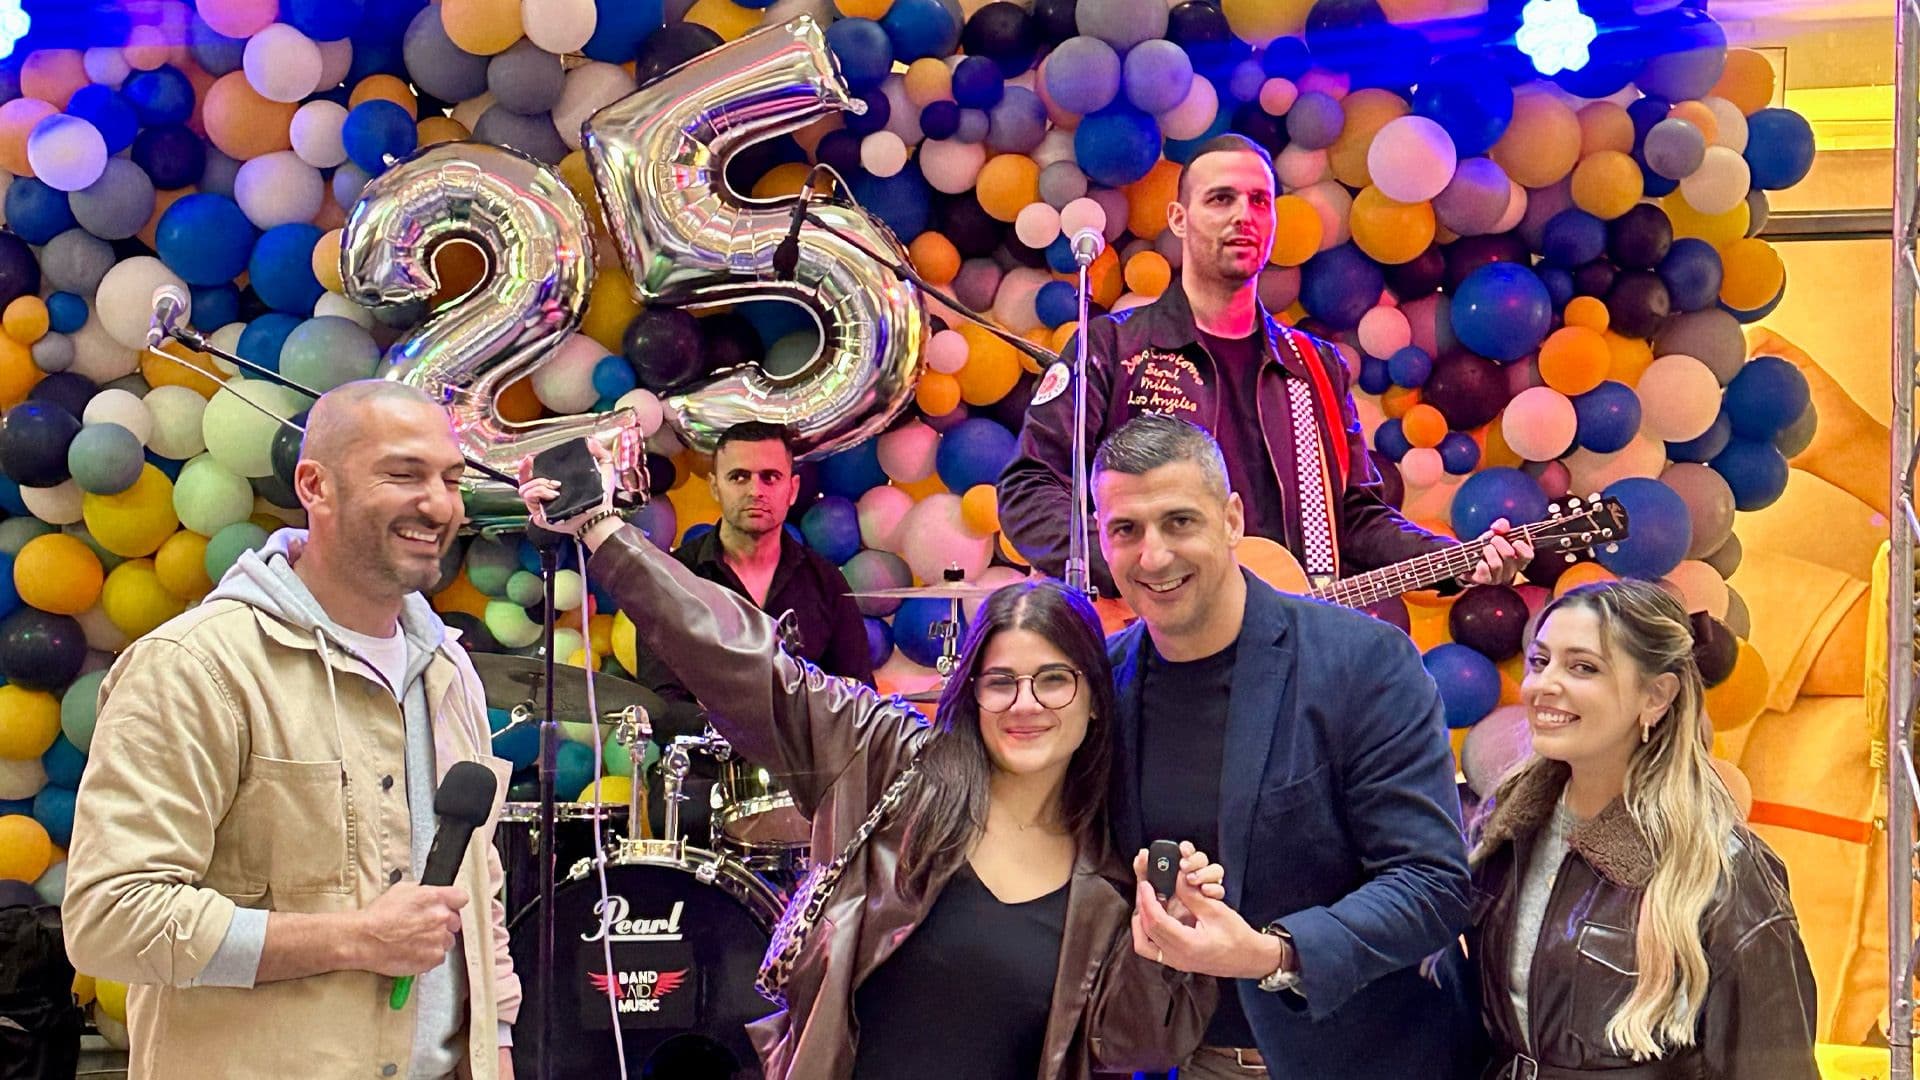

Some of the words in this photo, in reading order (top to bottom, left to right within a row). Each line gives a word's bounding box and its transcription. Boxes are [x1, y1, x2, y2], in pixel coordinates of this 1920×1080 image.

[340, 14, 931, 535] 25
[1141, 376, 1183, 394] Milan
[1127, 390, 1148, 405] Los
[1150, 392, 1197, 414] Angeles
[580, 895, 685, 942] Pearl
[618, 970, 658, 984] BAND
[618, 999, 660, 1012] MUSIC
